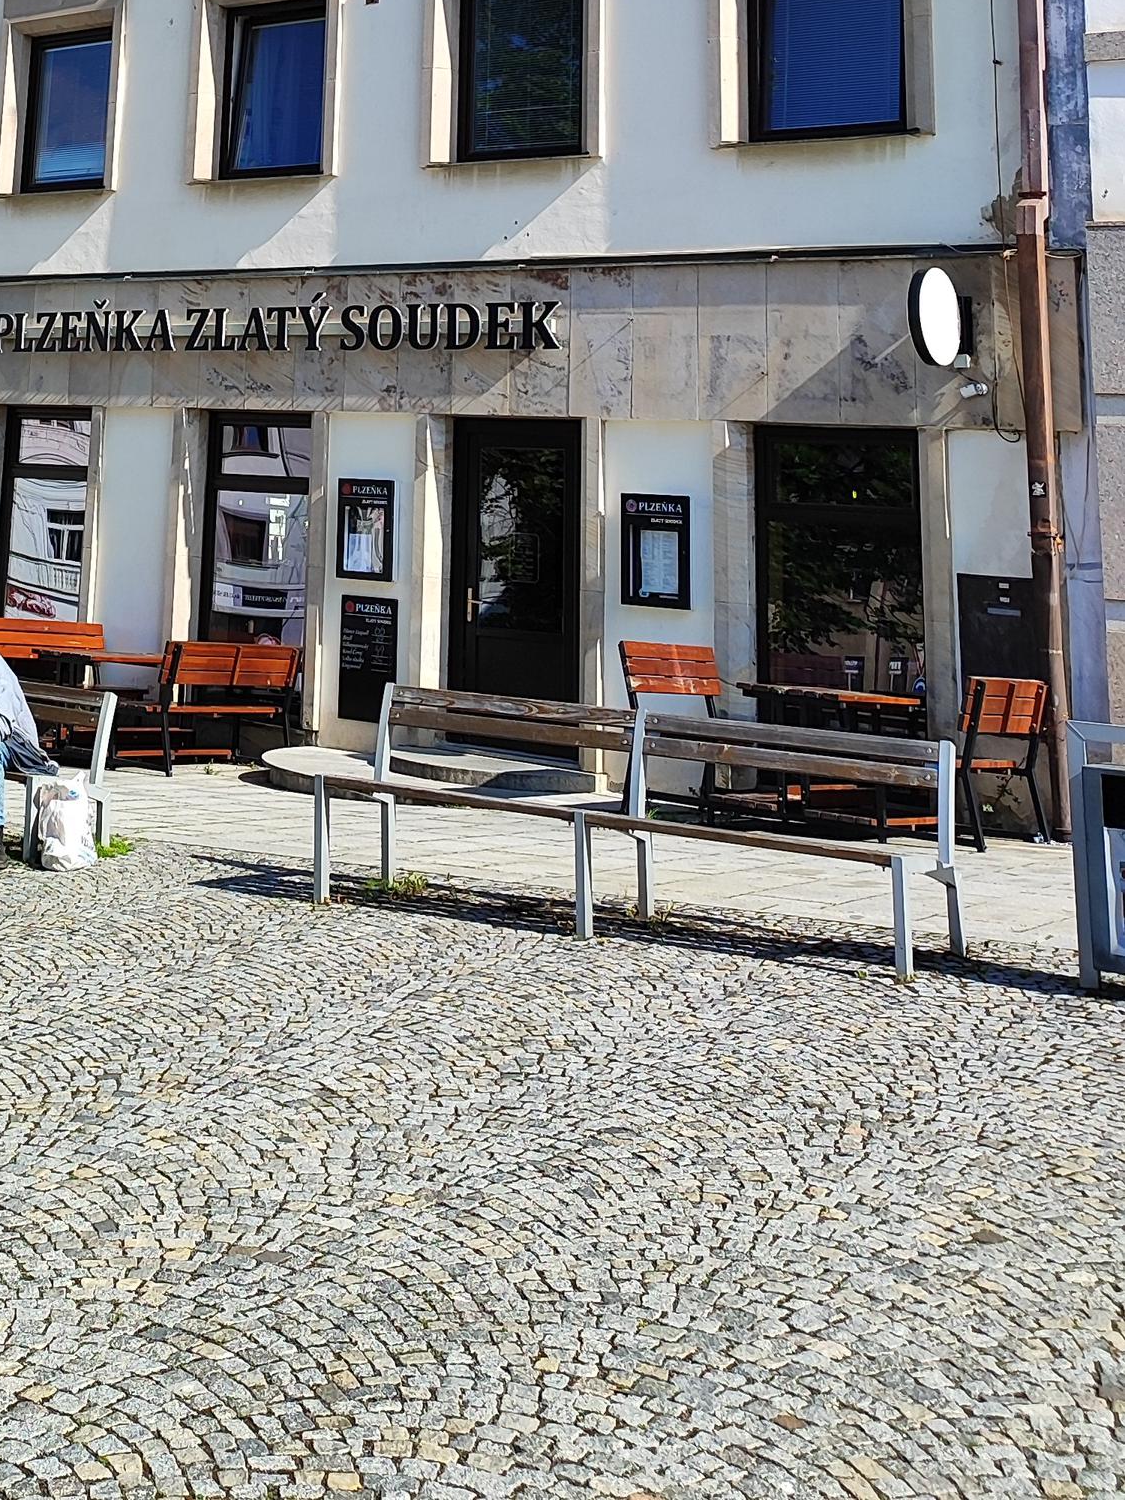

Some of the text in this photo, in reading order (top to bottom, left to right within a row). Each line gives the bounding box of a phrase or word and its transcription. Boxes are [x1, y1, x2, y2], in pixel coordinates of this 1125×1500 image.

[184, 292, 333, 352] ZLATÝ
[339, 300, 563, 351] SOUDEK
[352, 484, 388, 496] PLZEŇKA
[638, 501, 682, 513] PLZEŇKA
[355, 603, 392, 615] PLZEŇKA
